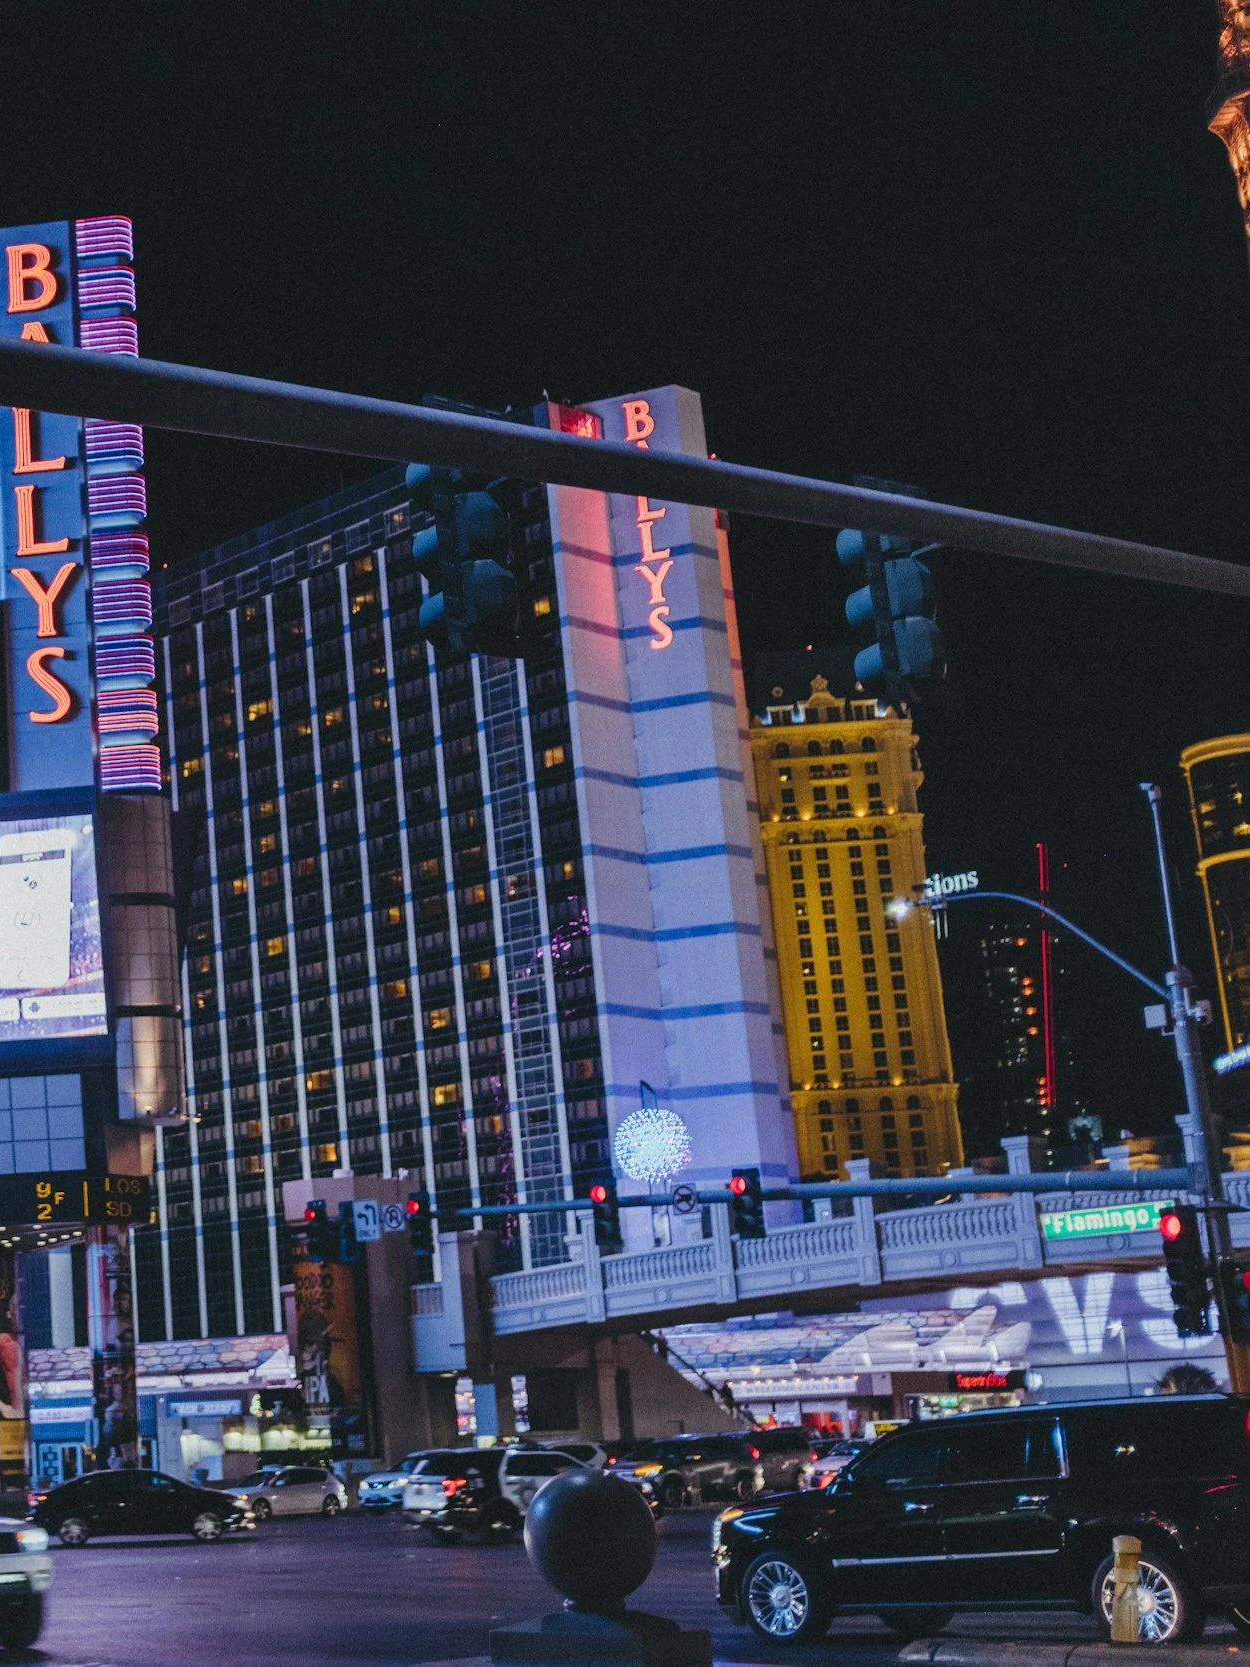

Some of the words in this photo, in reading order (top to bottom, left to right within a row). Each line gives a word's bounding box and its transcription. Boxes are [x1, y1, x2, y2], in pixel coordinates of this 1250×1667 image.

[5, 243, 77, 723] BLLYS
[622, 399, 674, 650] BLLYS
[35, 1182, 51, 1198] 9
[37, 1203, 52, 1220] 2
[106, 1201, 132, 1217] SD
[1051, 1207, 1149, 1233] Flamingo
[305, 1375, 330, 1404] IPA
